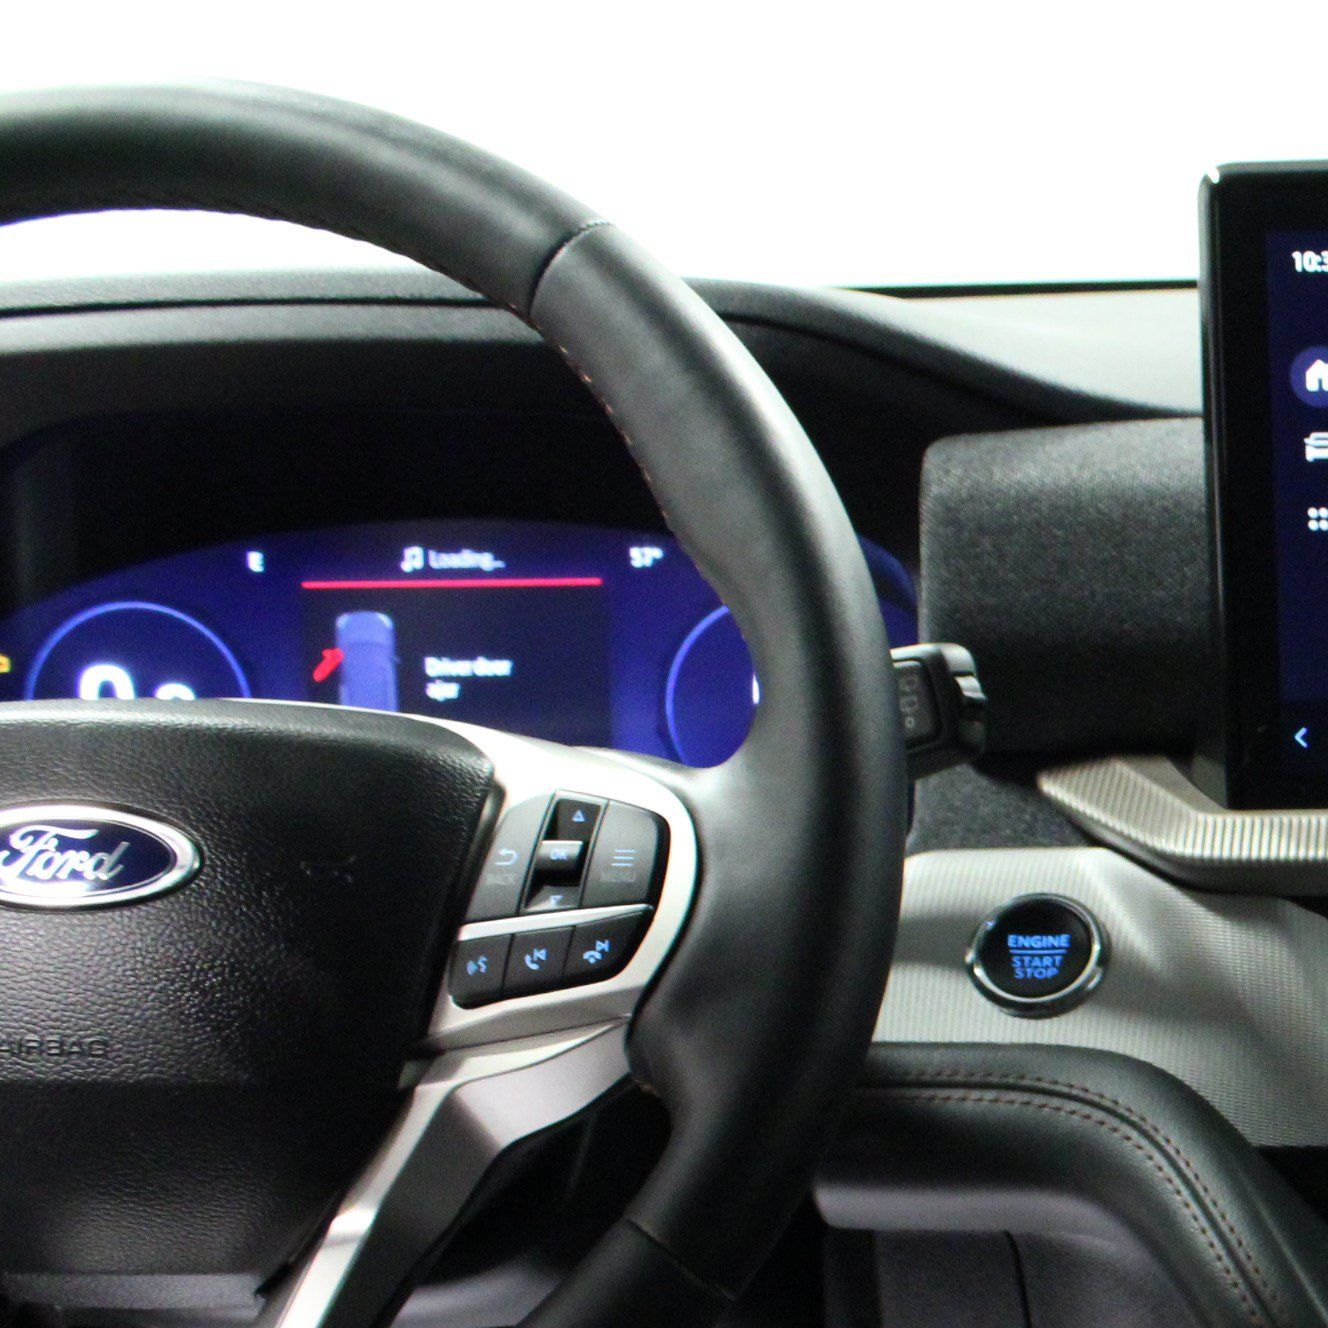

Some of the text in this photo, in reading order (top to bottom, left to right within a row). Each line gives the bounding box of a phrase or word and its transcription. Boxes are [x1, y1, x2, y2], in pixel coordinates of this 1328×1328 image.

[0, 823, 131, 881] Ford
[1007, 934, 1072, 948] ENGINE
[1011, 955, 1063, 968] START
[1014, 967, 1060, 980] STOP
